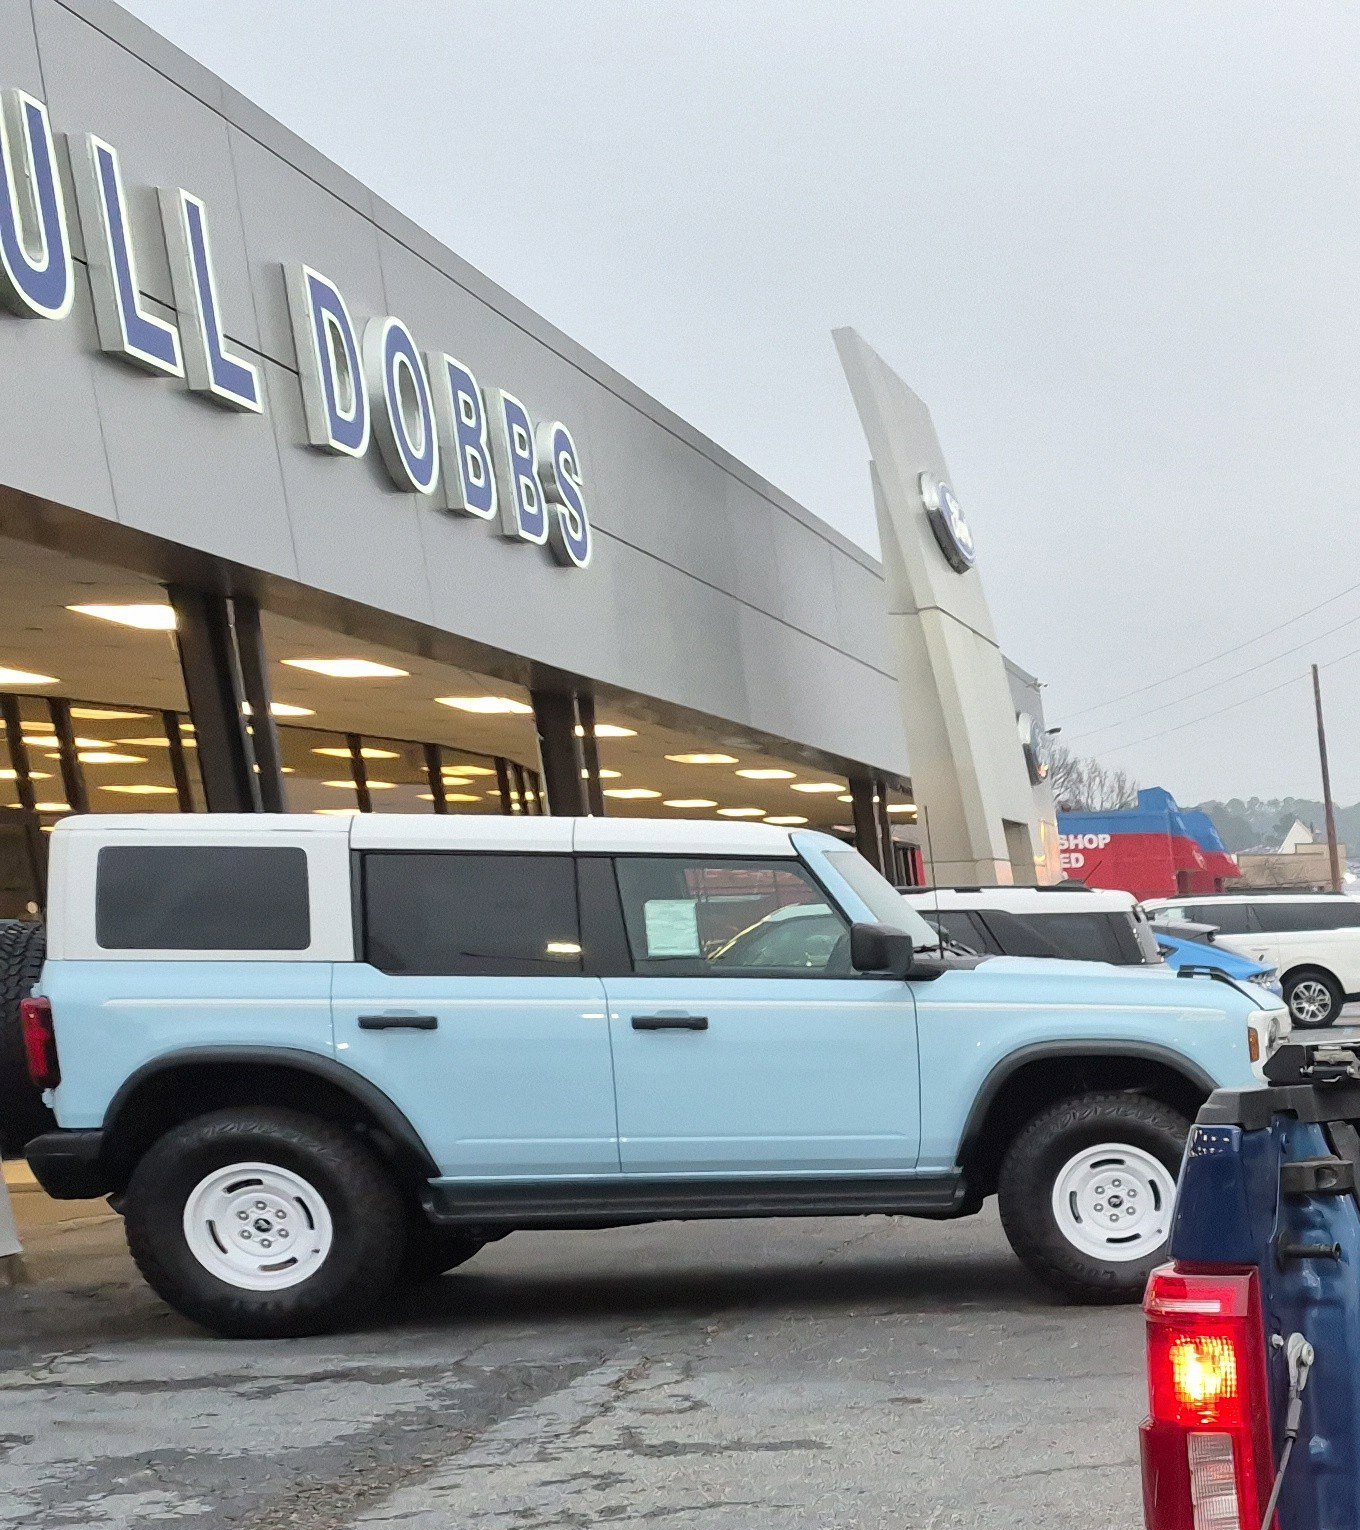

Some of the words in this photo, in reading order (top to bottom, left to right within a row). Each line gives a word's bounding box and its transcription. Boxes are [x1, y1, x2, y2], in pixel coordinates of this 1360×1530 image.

[0, 88, 263, 415] ULL
[302, 262, 592, 569] DOBBS
[1060, 834, 1111, 849] SHOP
